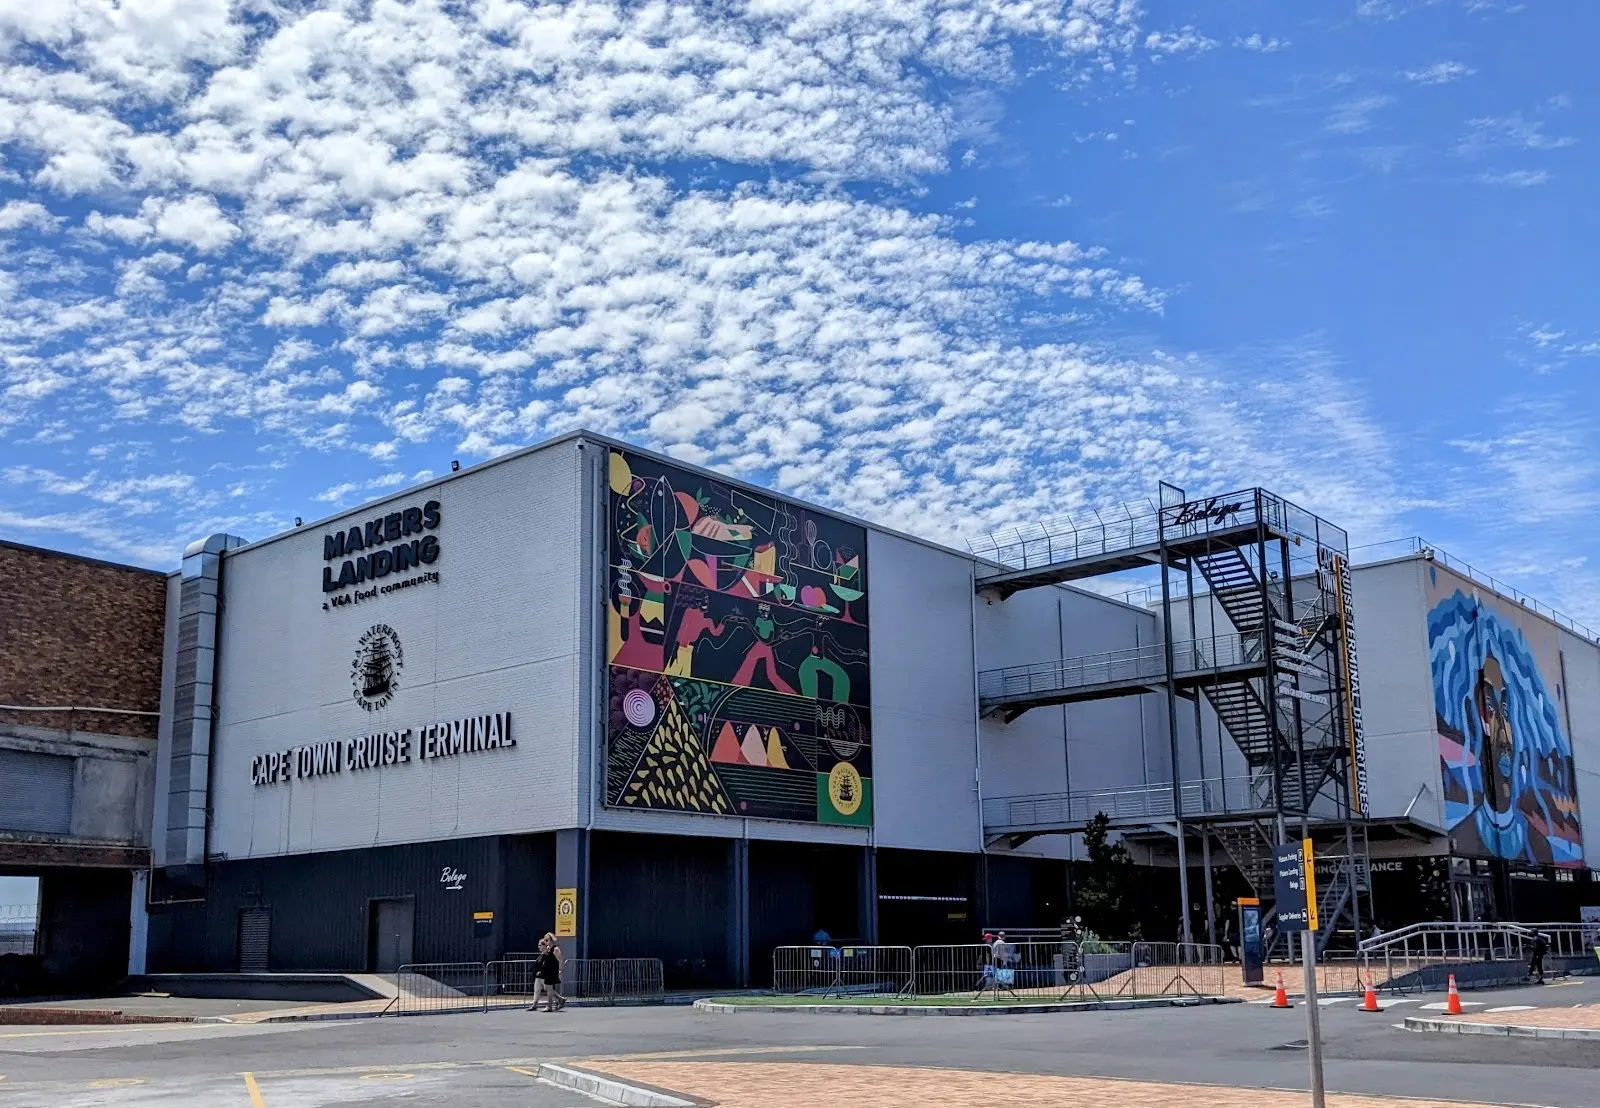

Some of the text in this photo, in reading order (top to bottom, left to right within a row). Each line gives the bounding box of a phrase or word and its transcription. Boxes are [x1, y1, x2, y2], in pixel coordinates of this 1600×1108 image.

[323, 500, 441, 561] MAKERS
[1175, 498, 1242, 525] Beluga
[322, 535, 440, 593] LANDING
[1319, 571, 1339, 596] TOWN
[322, 571, 440, 611] a V&A food community
[358, 623, 404, 669] WATERFRONT
[353, 681, 399, 712] CAPE TOWN
[1340, 557, 1369, 815] CRUISE TERMINAL DEPARTURES
[250, 711, 516, 786] CAPE TOWN CRUISE TERMINAL
[440, 866, 468, 887] Beluga
